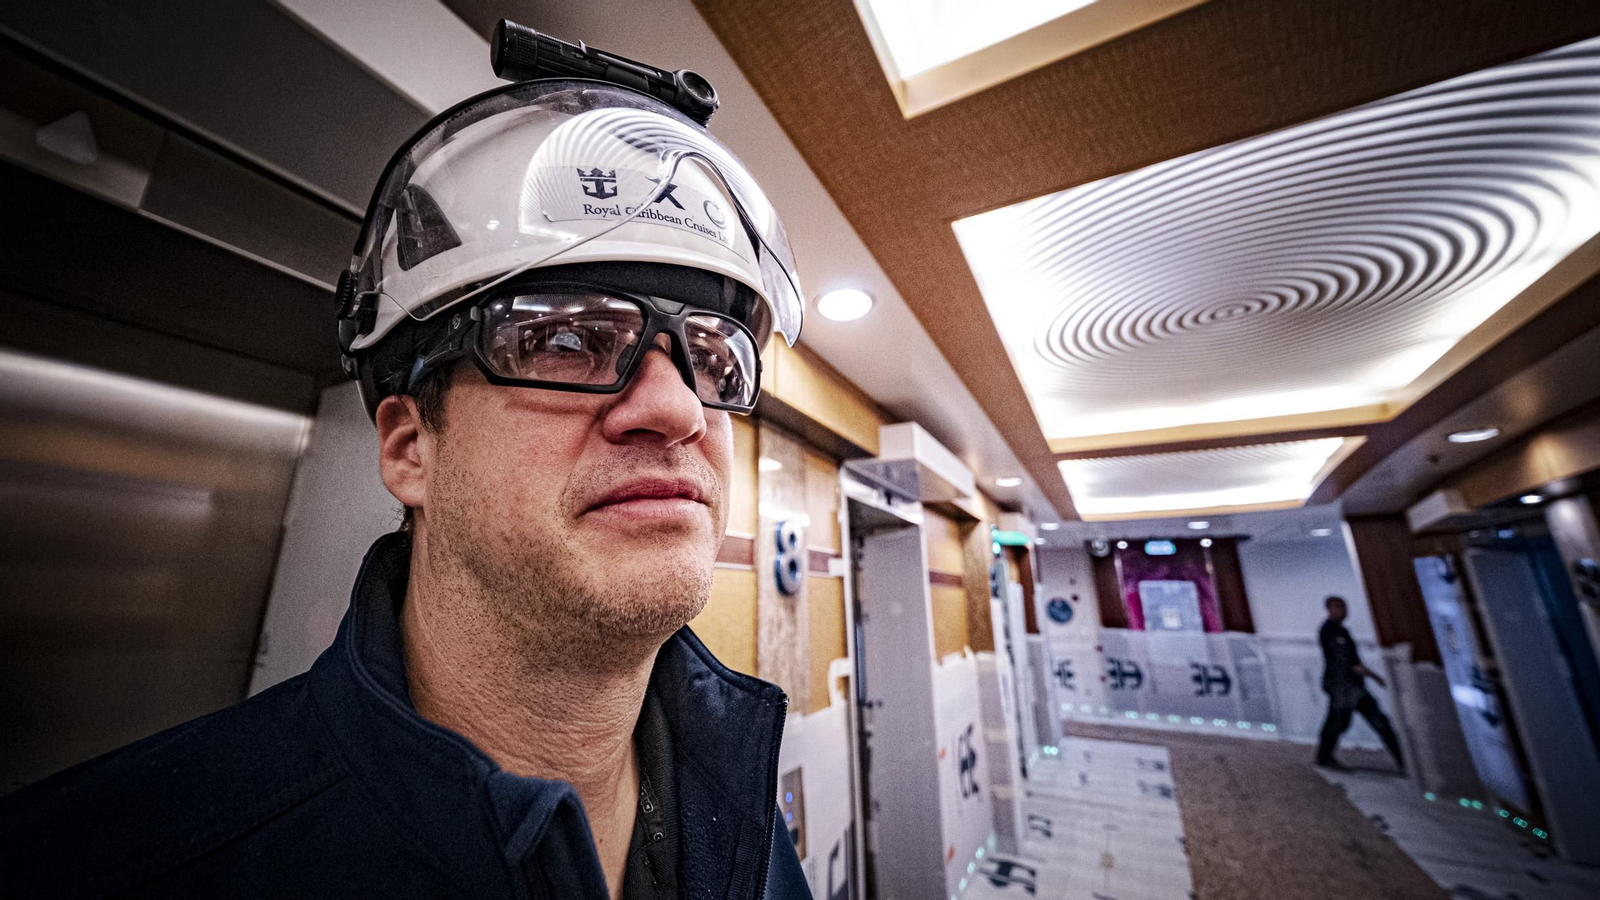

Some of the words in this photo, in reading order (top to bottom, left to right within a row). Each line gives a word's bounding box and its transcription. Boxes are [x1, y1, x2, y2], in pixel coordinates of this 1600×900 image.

[583, 203, 622, 218] Royal
[684, 217, 717, 238] Cruises
[774, 519, 803, 597] 8
